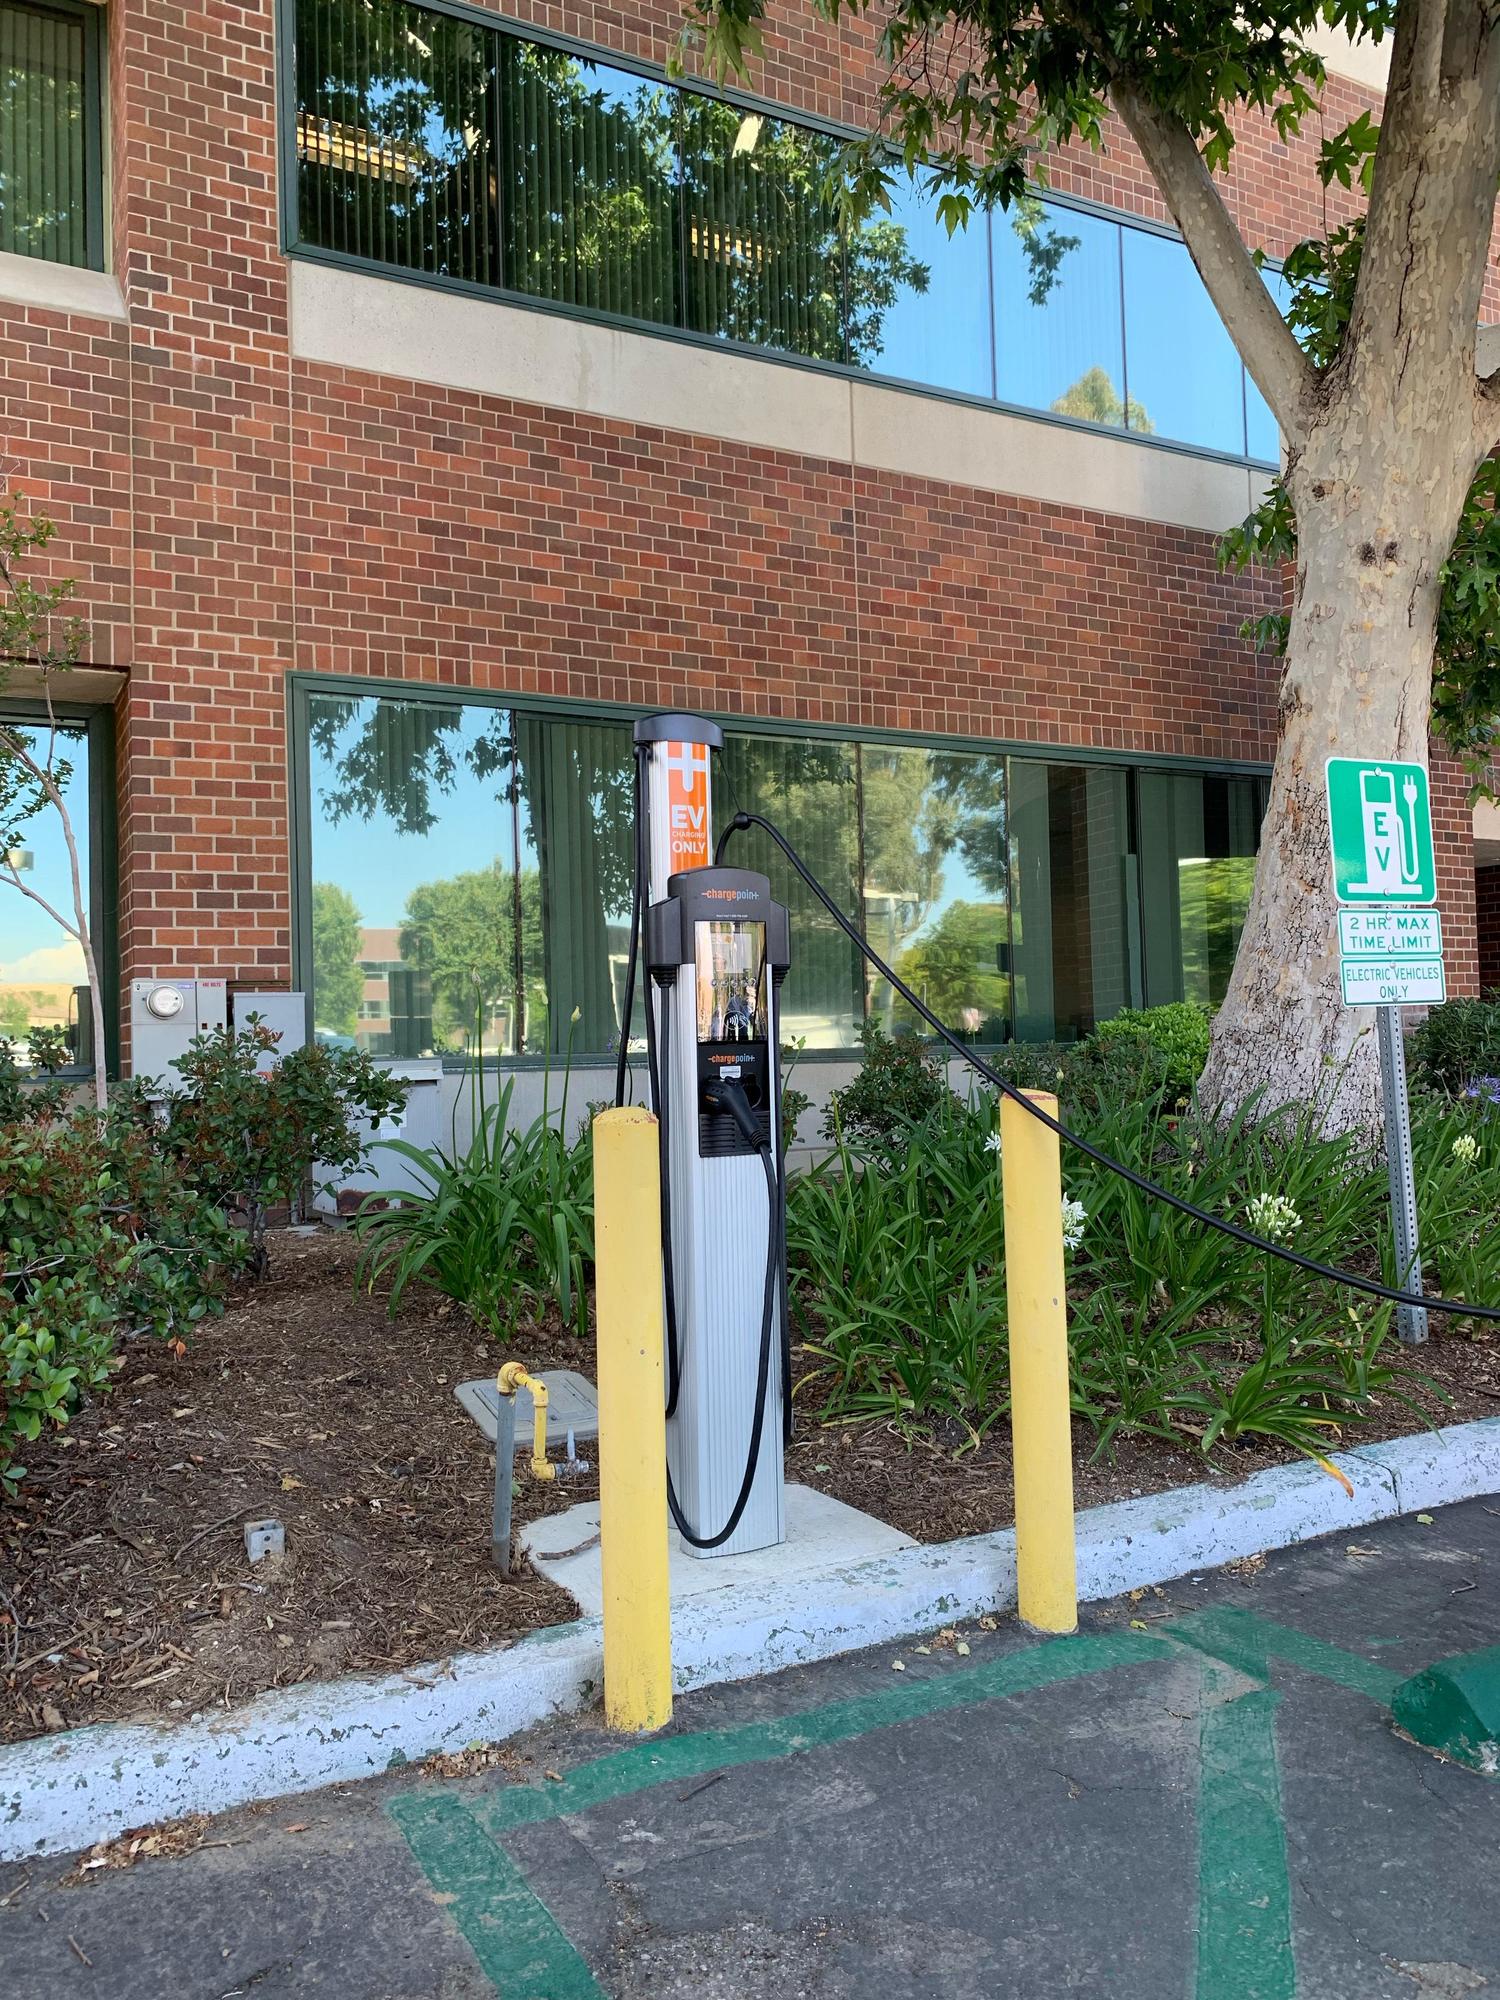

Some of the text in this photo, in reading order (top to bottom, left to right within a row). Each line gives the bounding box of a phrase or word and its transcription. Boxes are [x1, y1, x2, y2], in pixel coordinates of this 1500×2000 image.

[671, 804, 705, 829] EV
[671, 831, 705, 839] CHARGING
[671, 840, 706, 855] ONLY
[701, 888, 759, 901] chargepoint
[1350, 917, 1359, 930] 2
[1397, 917, 1430, 930] MAX
[1349, 935, 1432, 949] TIME LIMIT
[1346, 967, 1439, 981] ELECTRIC VEHICLES
[1379, 985, 1409, 998] ONLY
[707, 1053, 756, 1065] chargepoint
